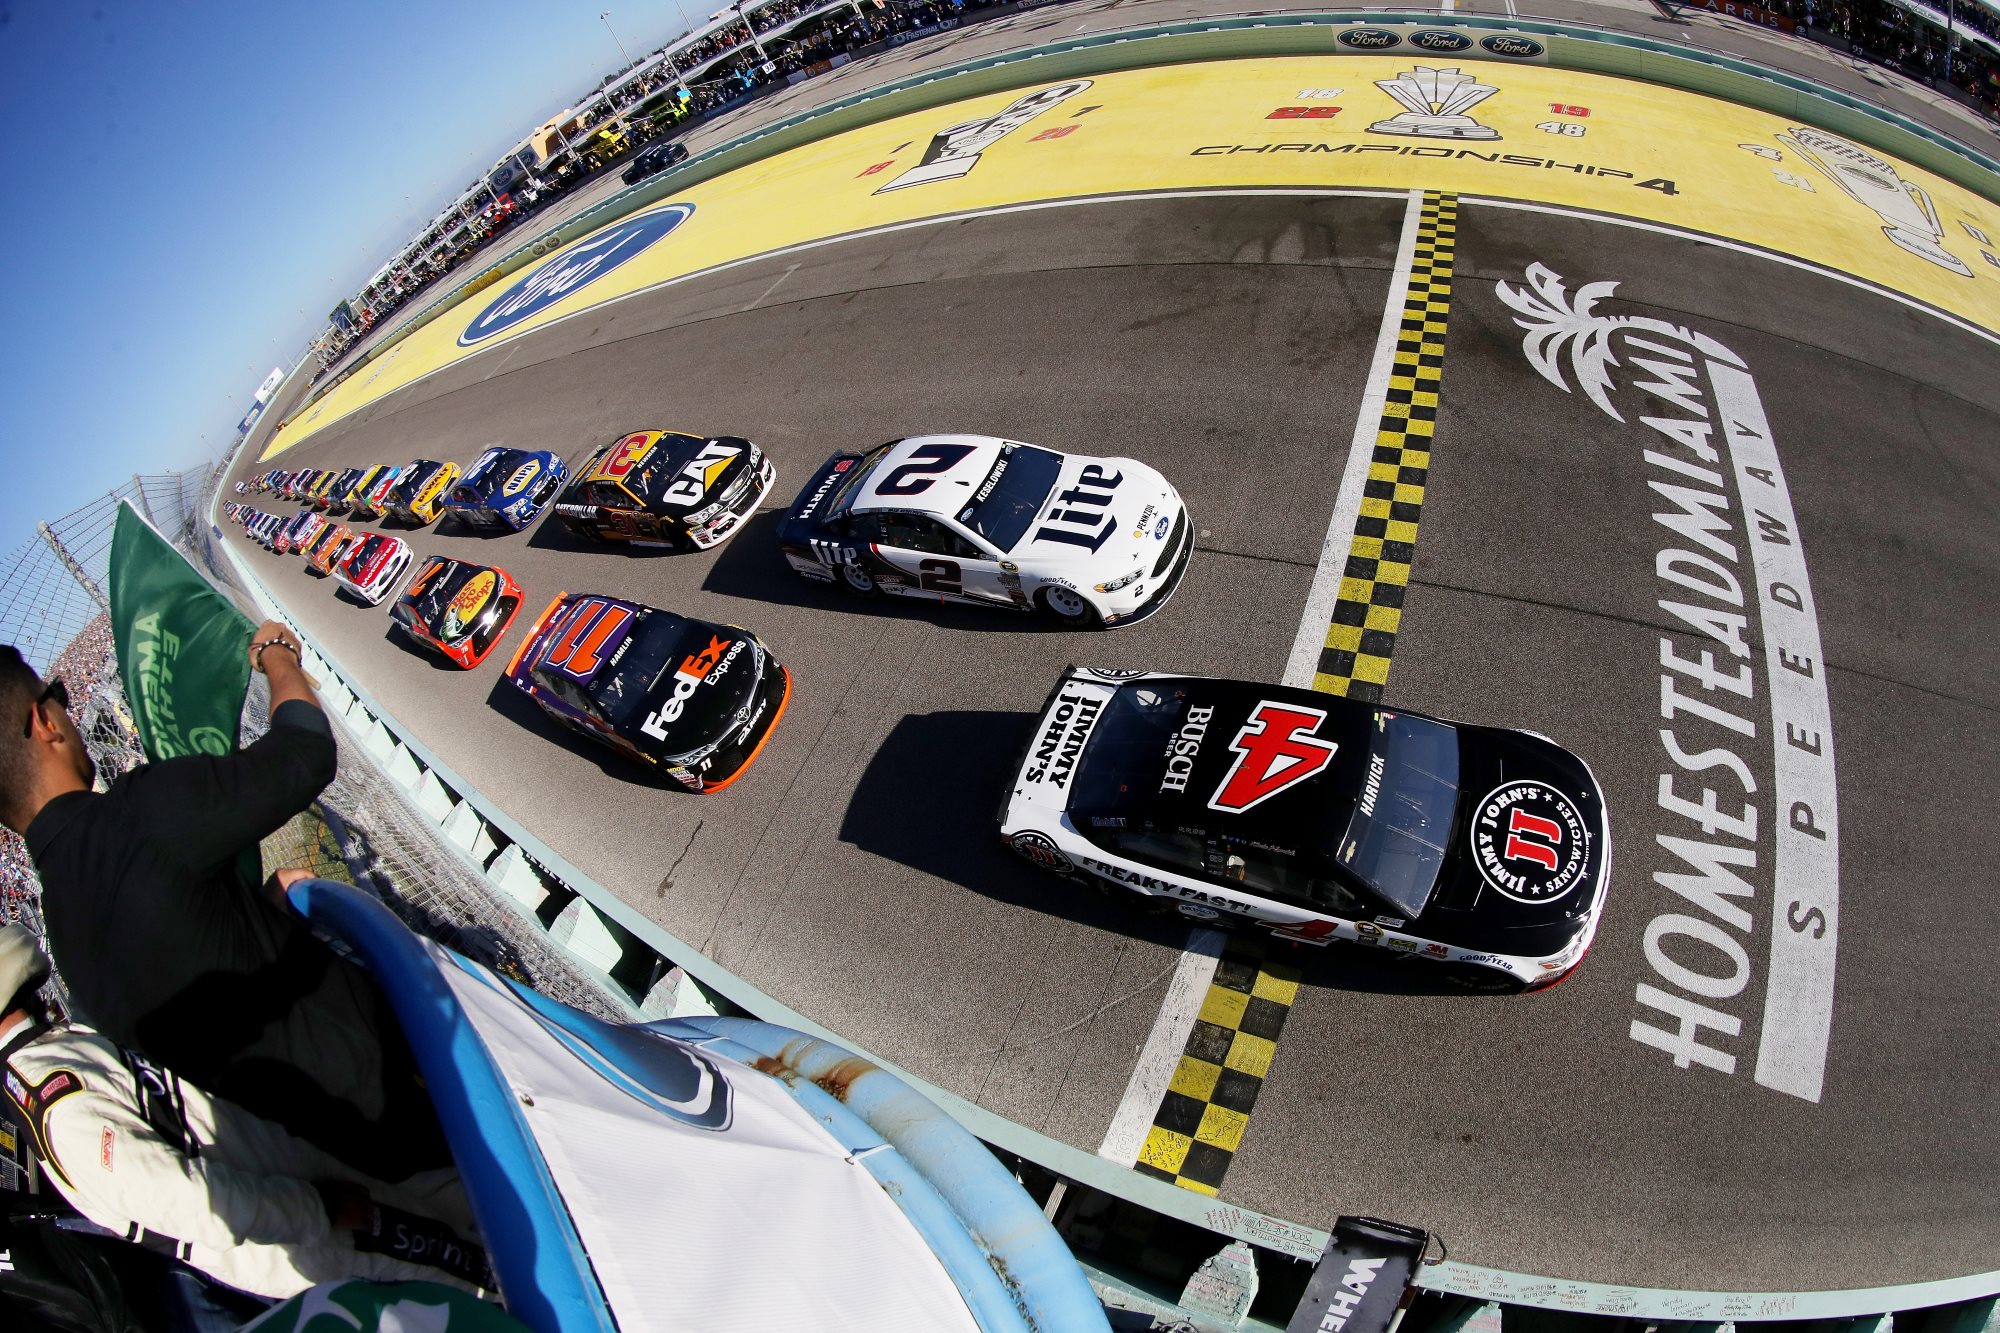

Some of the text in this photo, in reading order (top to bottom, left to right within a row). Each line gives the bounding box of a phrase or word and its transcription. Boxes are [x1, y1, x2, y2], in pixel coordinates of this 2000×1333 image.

[1704, 0, 1780, 27] ARRIS
[905, 25, 939, 40] FASTENAL
[1349, 29, 1394, 48] Ford
[1420, 32, 1466, 50] Ford
[1492, 36, 1535, 56] Ford
[764, 63, 775, 73] 38
[1294, 87, 1345, 99] 18
[1547, 102, 1592, 118] 19
[1263, 105, 1344, 120] 22
[1535, 121, 1588, 138] 48
[1190, 144, 1681, 196] CHAMPIONSHIP 4
[637, 446, 658, 469] NEWMAN
[662, 439, 743, 507] CAT
[874, 443, 979, 496] 2
[507, 464, 536, 491] NAPA
[976, 459, 1009, 503] KESELOWSKI
[1032, 463, 1124, 556] Lite
[1136, 504, 1156, 531] PENNZOIL
[1155, 517, 1169, 537] Ford
[361, 541, 398, 588] Motorcraft
[919, 558, 963, 595] 2
[453, 581, 475, 608] Bass
[461, 588, 477, 610] Pro
[464, 579, 494, 614] Shops
[1134, 584, 1144, 598] 2
[545, 600, 633, 678] 11
[610, 636, 633, 667] HAMLIN
[704, 640, 747, 686] Express
[1733, 419, 1827, 940] SPEEDWAY
[640, 634, 732, 742] FedEx
[1025, 693, 1075, 785] JOHN'S
[1049, 697, 1104, 790] JIMMY
[1159, 703, 1215, 794] BUSCH
[1164, 732, 1179, 758] BEER
[700, 757, 713, 772] 11
[1206, 699, 1340, 815] 4
[1359, 753, 1386, 818] HARVICK
[1479, 787, 1540, 893] JIMMY JOHN'S
[1504, 807, 1562, 872] JJ
[1546, 801, 1583, 893] SANDWICHES
[1082, 856, 1252, 914] FREAKY FAST!
[1425, 943, 1449, 955] 3M
[1459, 954, 1514, 971] GOODYEAR
[42, 1074, 69, 1100] SIMPSON
[103, 1130, 113, 1169] SIMPSON
[393, 1223, 475, 1272] Sprint
[1317, 1257, 1388, 1333] WHE
